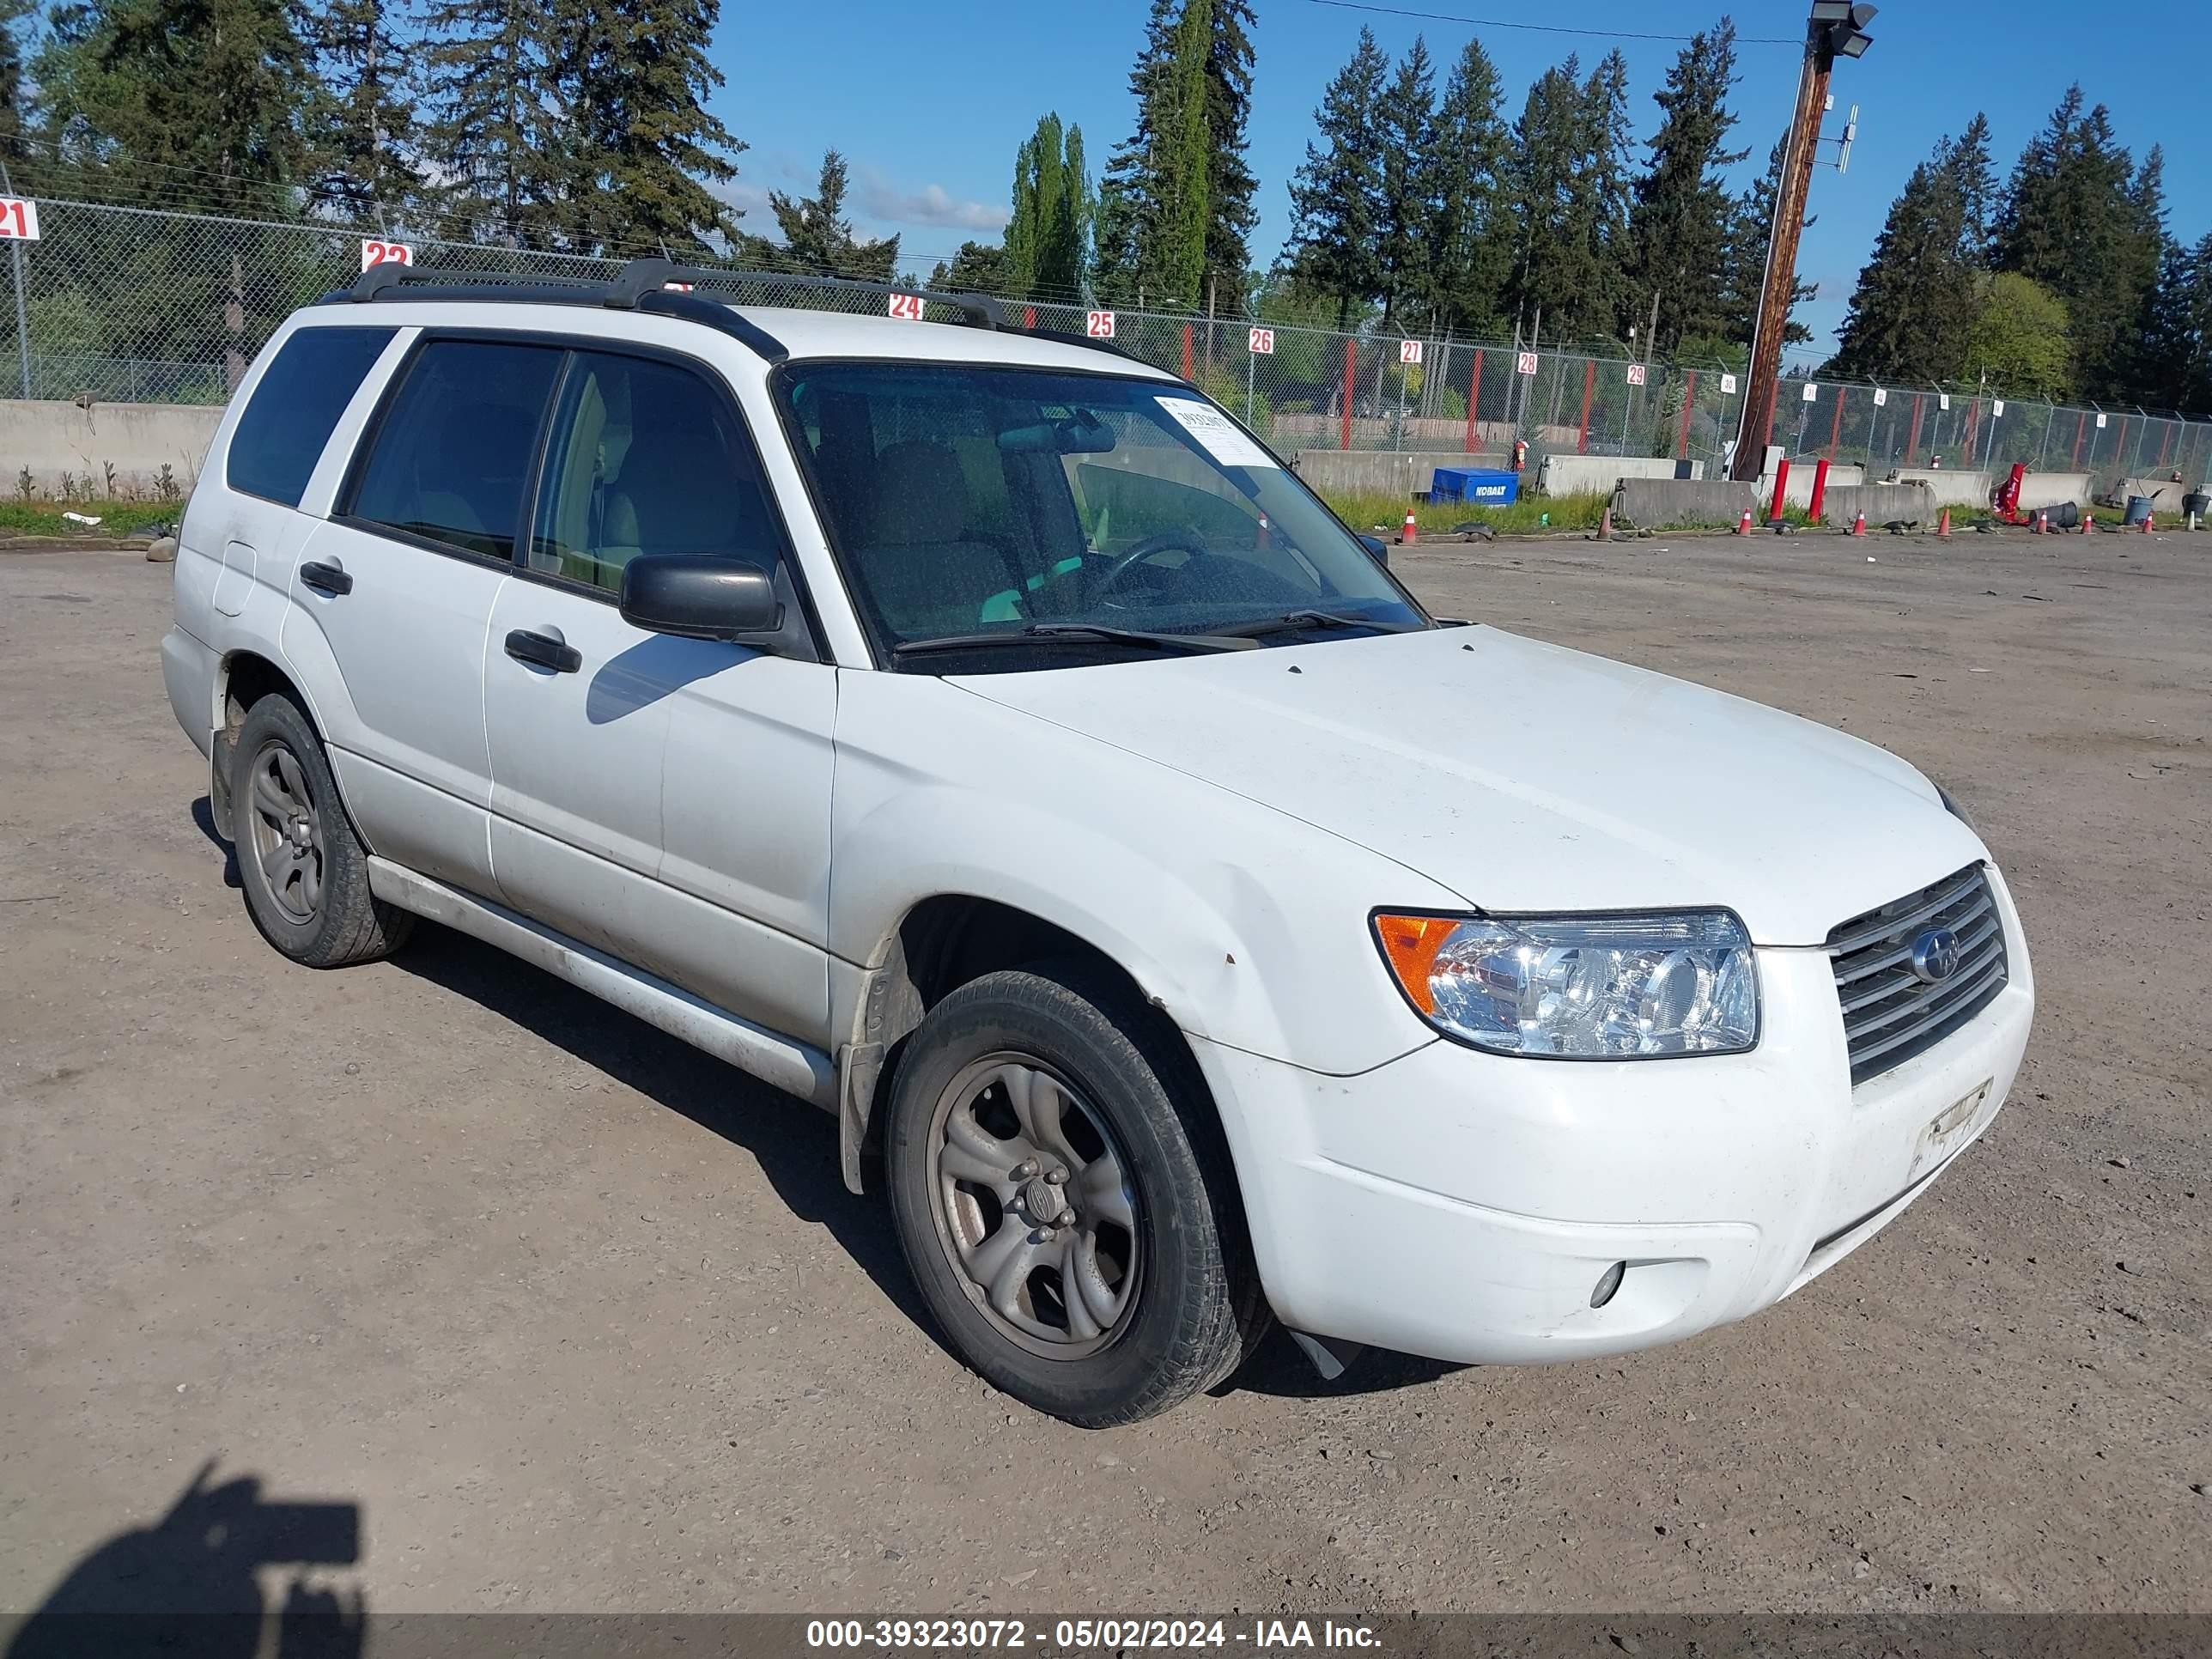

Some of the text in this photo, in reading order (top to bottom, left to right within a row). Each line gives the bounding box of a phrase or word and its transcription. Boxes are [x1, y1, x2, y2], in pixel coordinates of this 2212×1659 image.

[892, 294, 920, 319] 24
[1091, 313, 1111, 335] 25
[1251, 330, 1271, 351] 26
[1404, 342, 1419, 361] 27
[1521, 354, 1535, 372] 28
[1629, 366, 1643, 383] 29
[1725, 379, 1733, 389] 30
[1476, 486, 1507, 495] KOBALT
